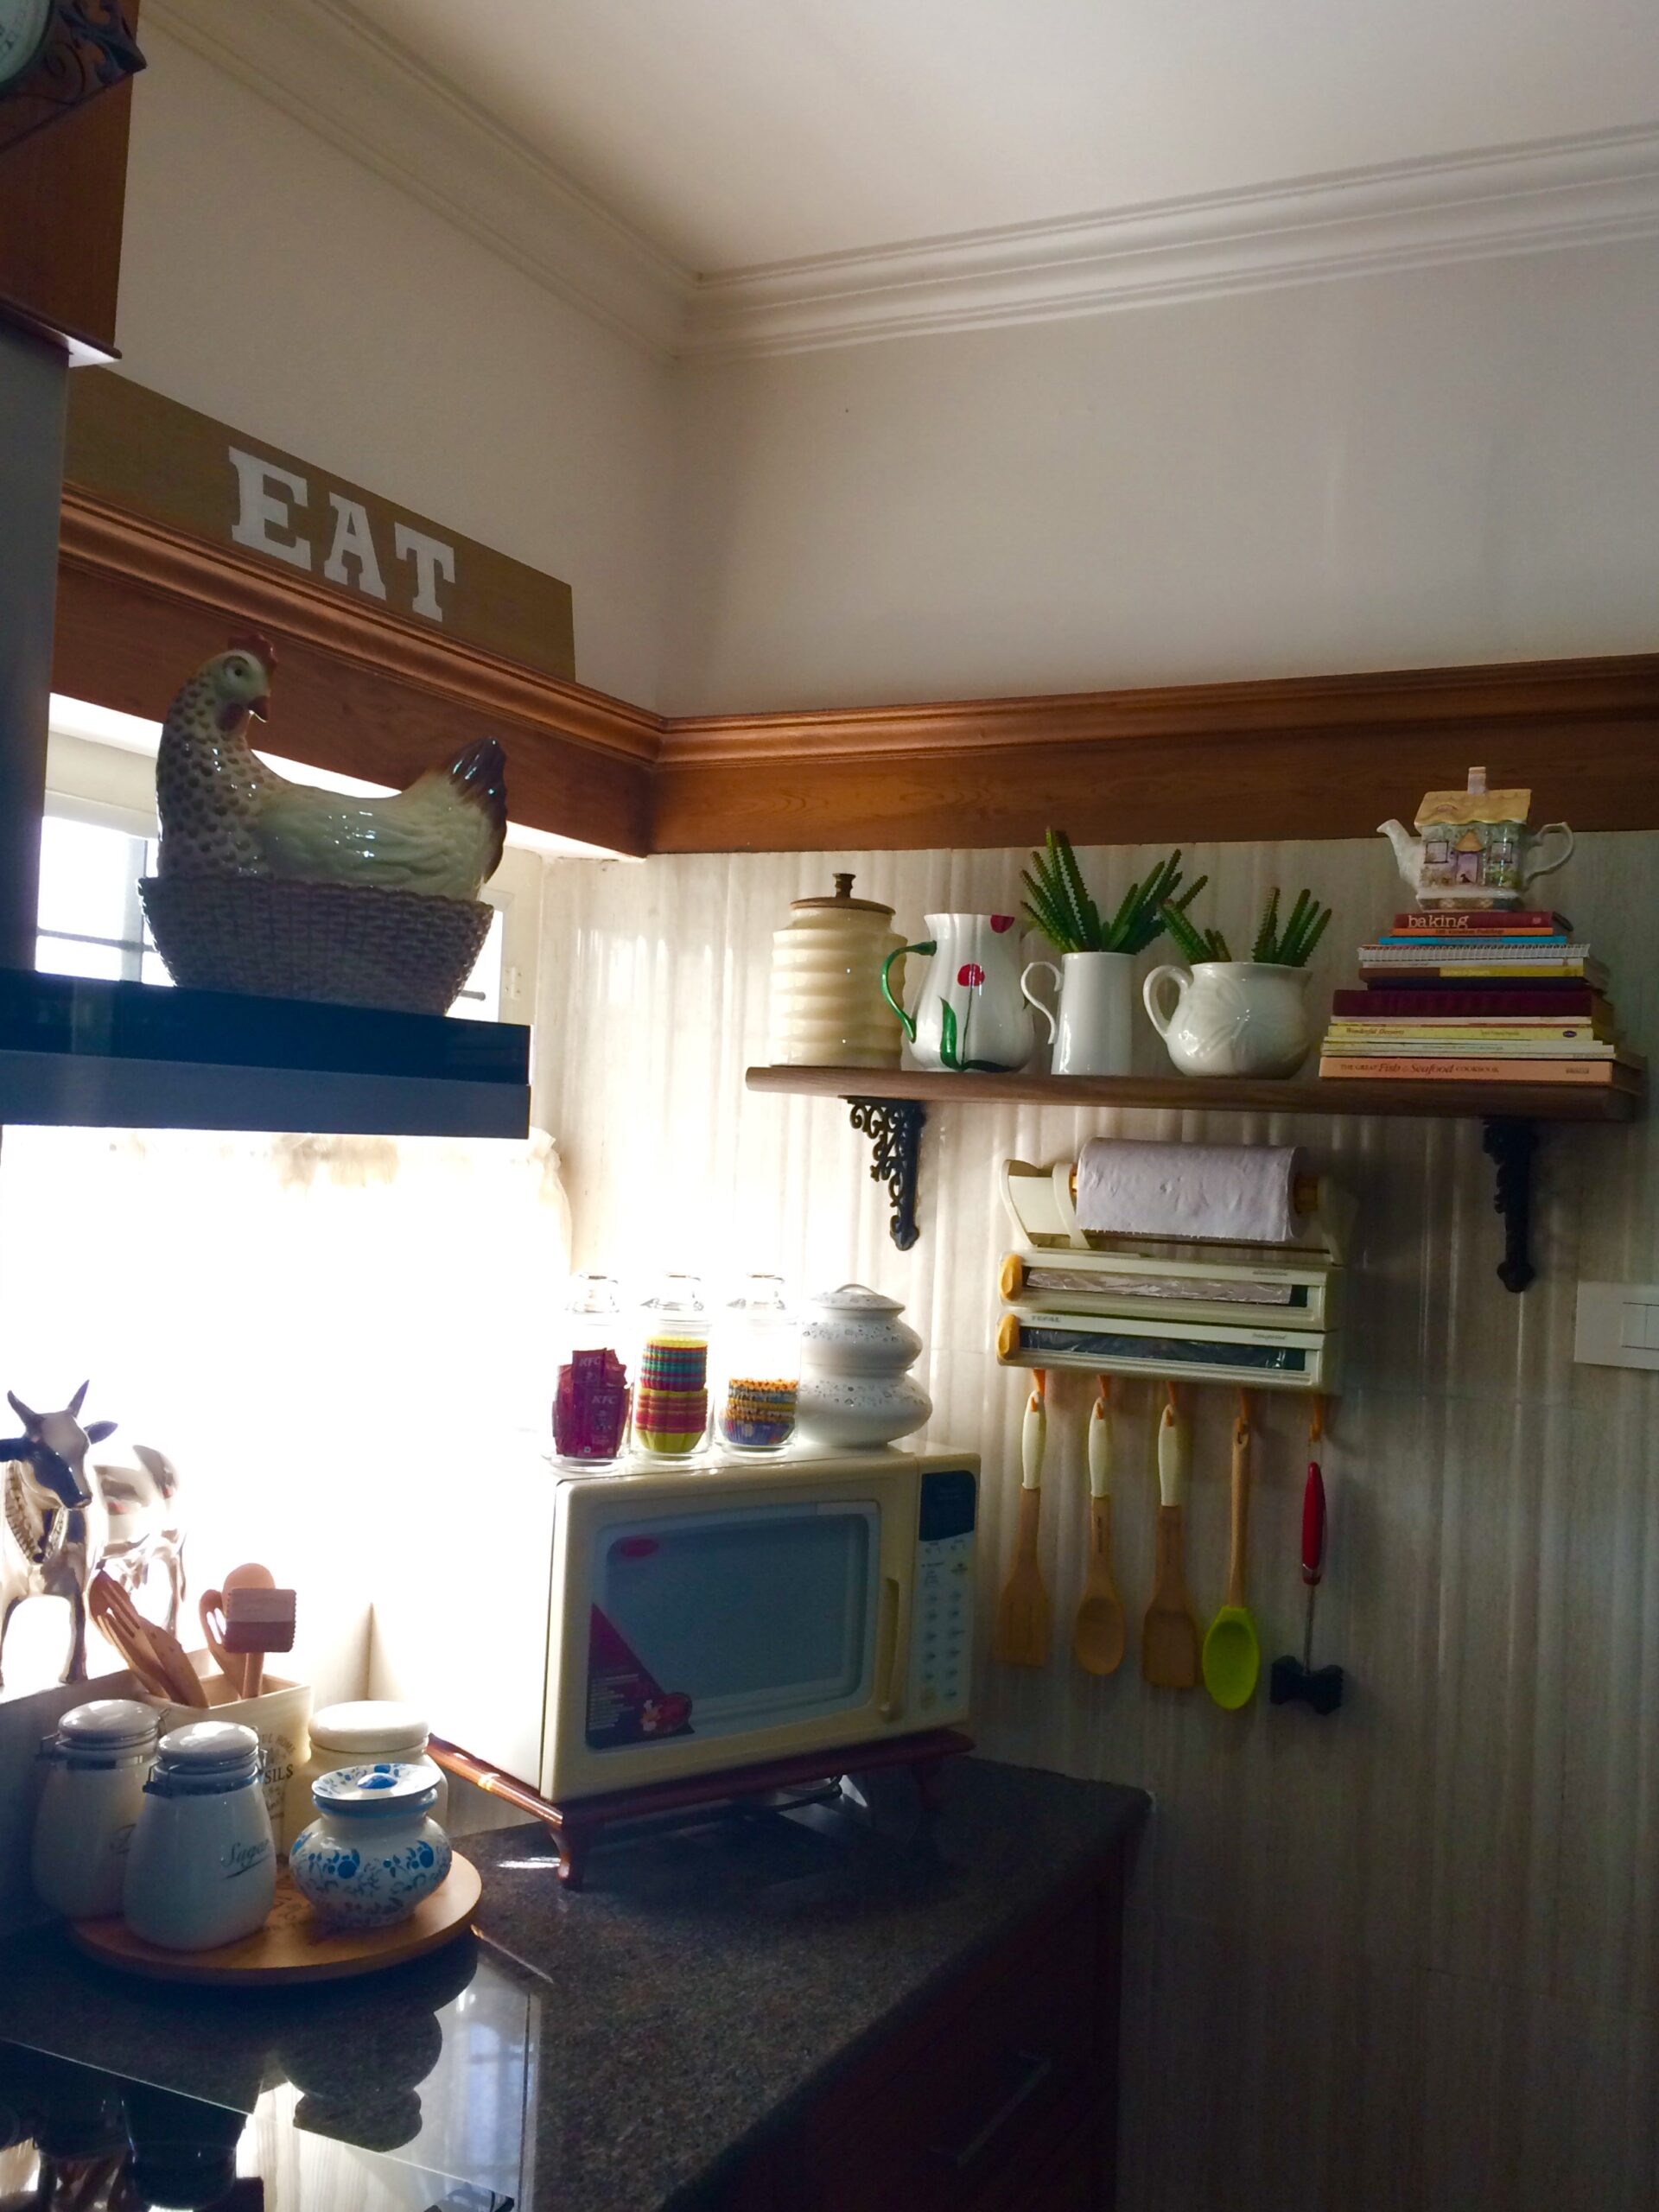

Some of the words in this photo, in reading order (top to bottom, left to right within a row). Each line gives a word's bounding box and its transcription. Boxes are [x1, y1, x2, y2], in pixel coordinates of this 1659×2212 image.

[228, 445, 456, 623] EAT
[1408, 914, 1470, 930] baking
[1378, 1063, 1402, 1073] Fish
[1411, 1063, 1455, 1075] Seafood
[579, 1356, 601, 1367] KFC
[591, 1395, 618, 1404] KFC
[221, 1837, 270, 1869] Sugar
